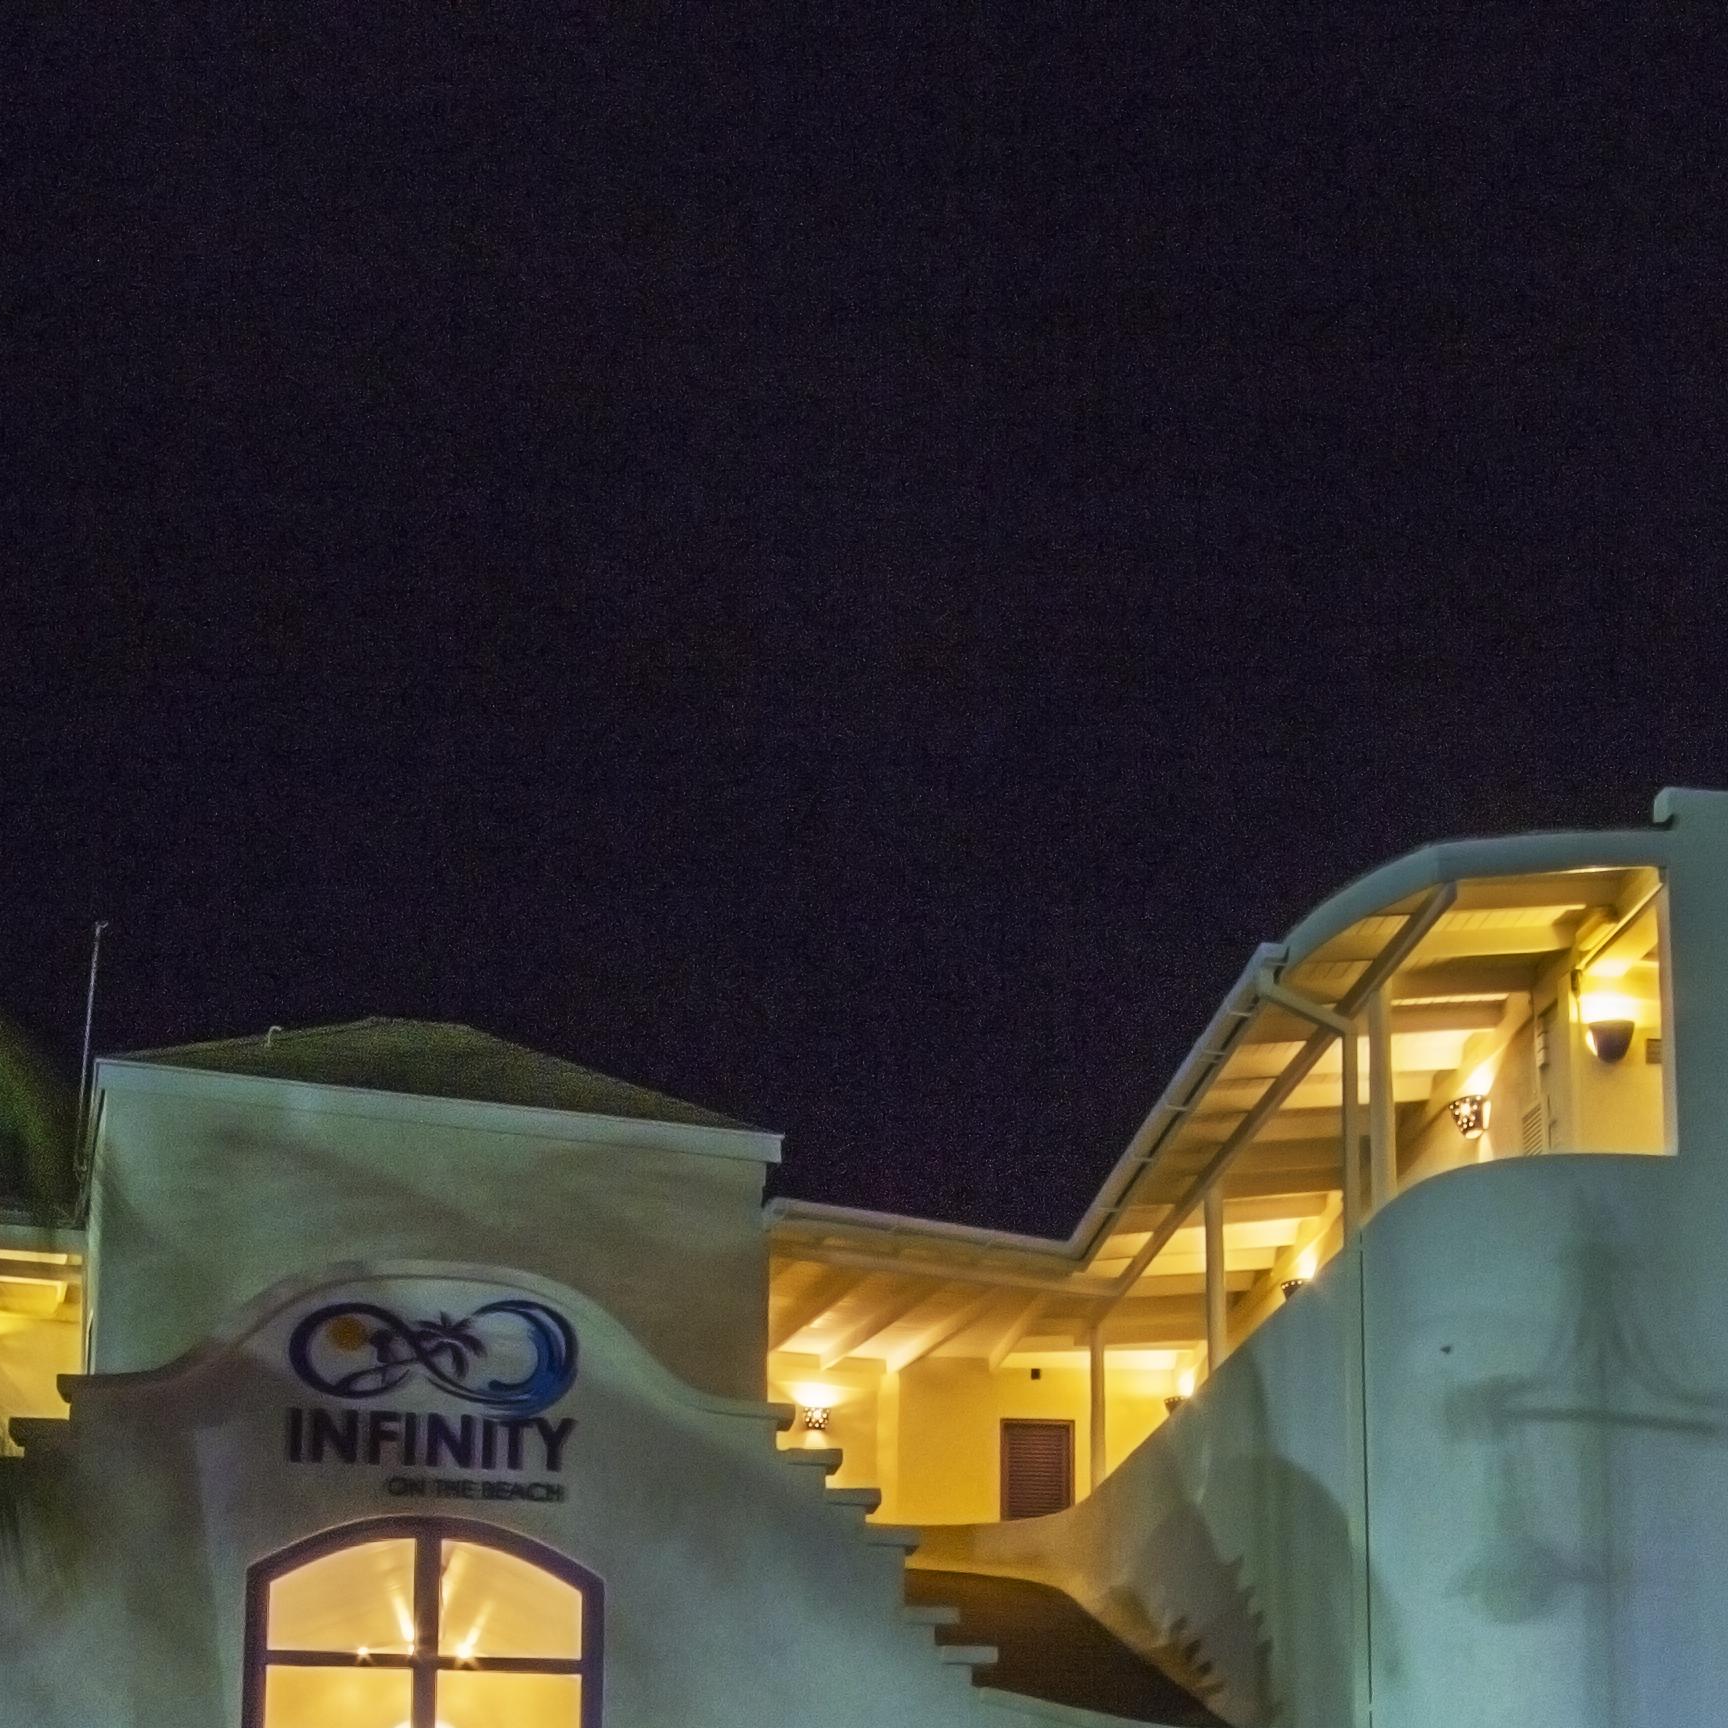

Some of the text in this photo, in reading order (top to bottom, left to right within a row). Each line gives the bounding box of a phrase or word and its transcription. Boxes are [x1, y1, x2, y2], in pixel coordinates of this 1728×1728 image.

[287, 1407, 577, 1472] INFINITY
[387, 1476, 564, 1503] ON THE BEACH
